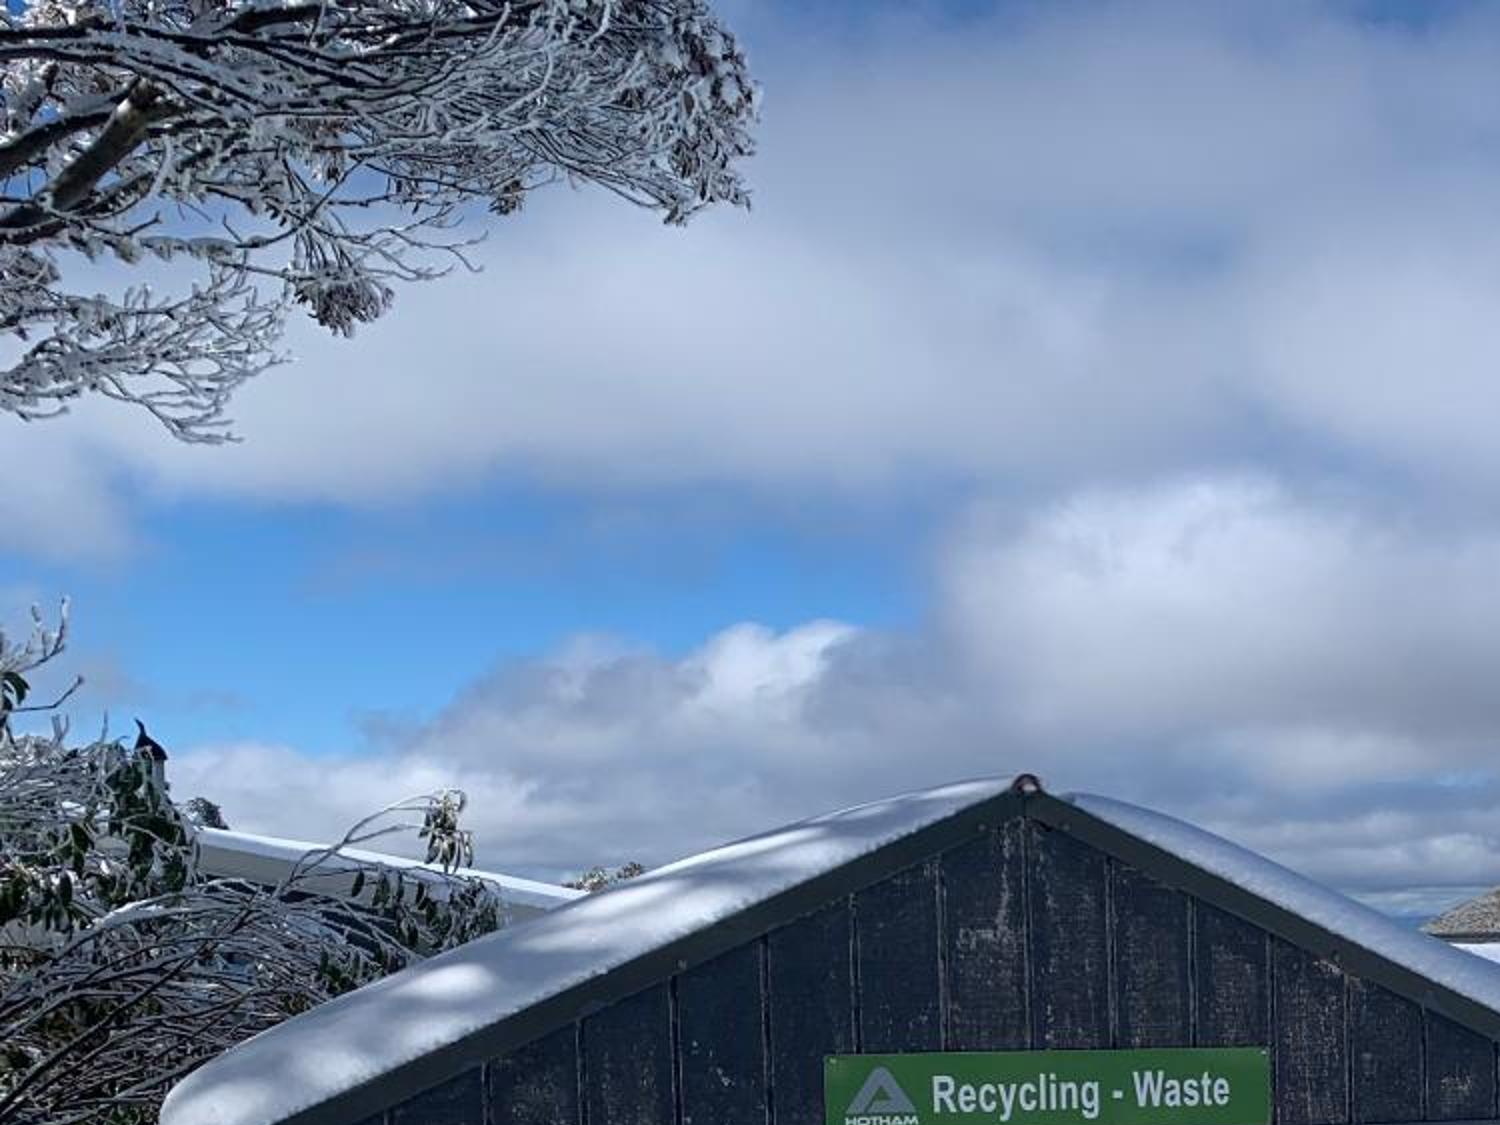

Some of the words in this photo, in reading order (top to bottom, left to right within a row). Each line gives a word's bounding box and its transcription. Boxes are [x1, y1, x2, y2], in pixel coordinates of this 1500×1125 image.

[932, 1073, 1100, 1120] Recycling
[1112, 1089, 1124, 1099] -
[1133, 1070, 1230, 1107] Waste
